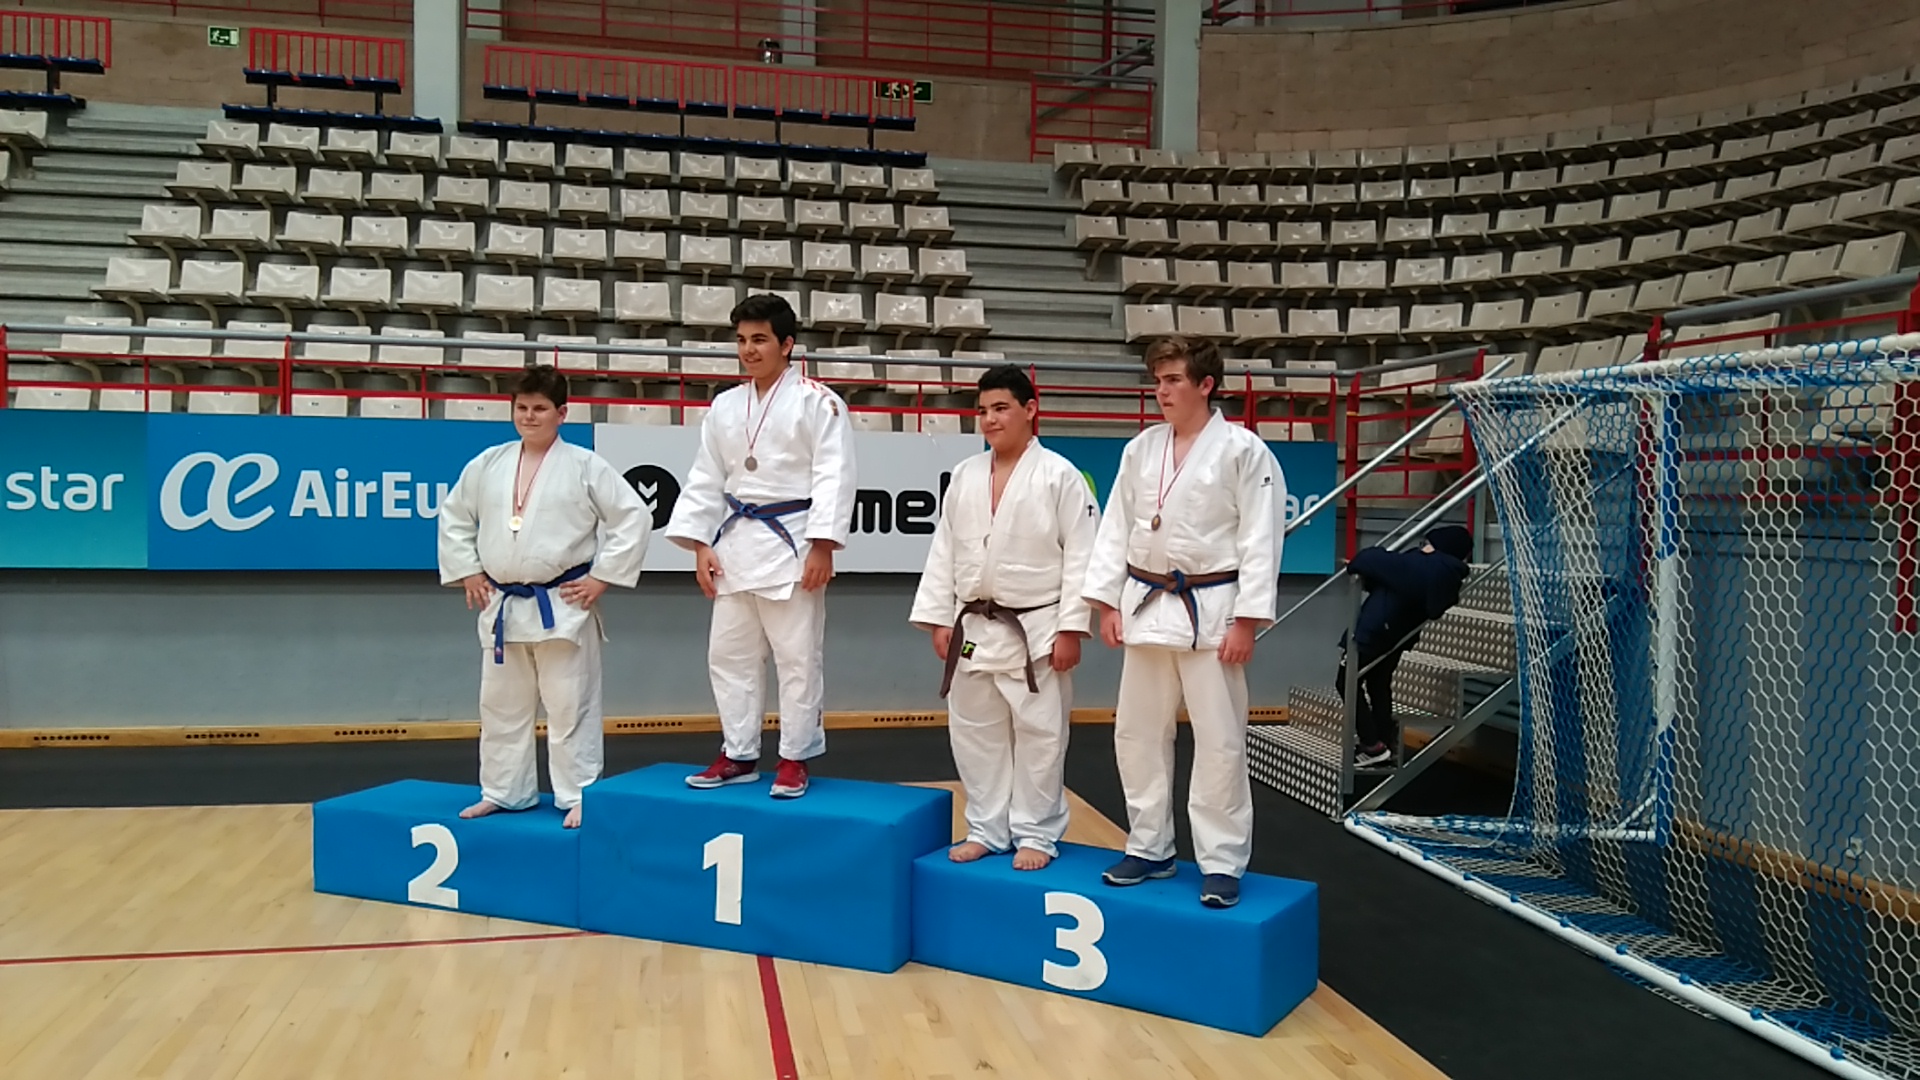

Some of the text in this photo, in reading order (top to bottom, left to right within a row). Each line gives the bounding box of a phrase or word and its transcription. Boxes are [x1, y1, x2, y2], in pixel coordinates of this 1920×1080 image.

[6, 466, 124, 511] star
[408, 823, 459, 909] 2
[702, 832, 743, 925] 1
[1042, 891, 1108, 991] 3
